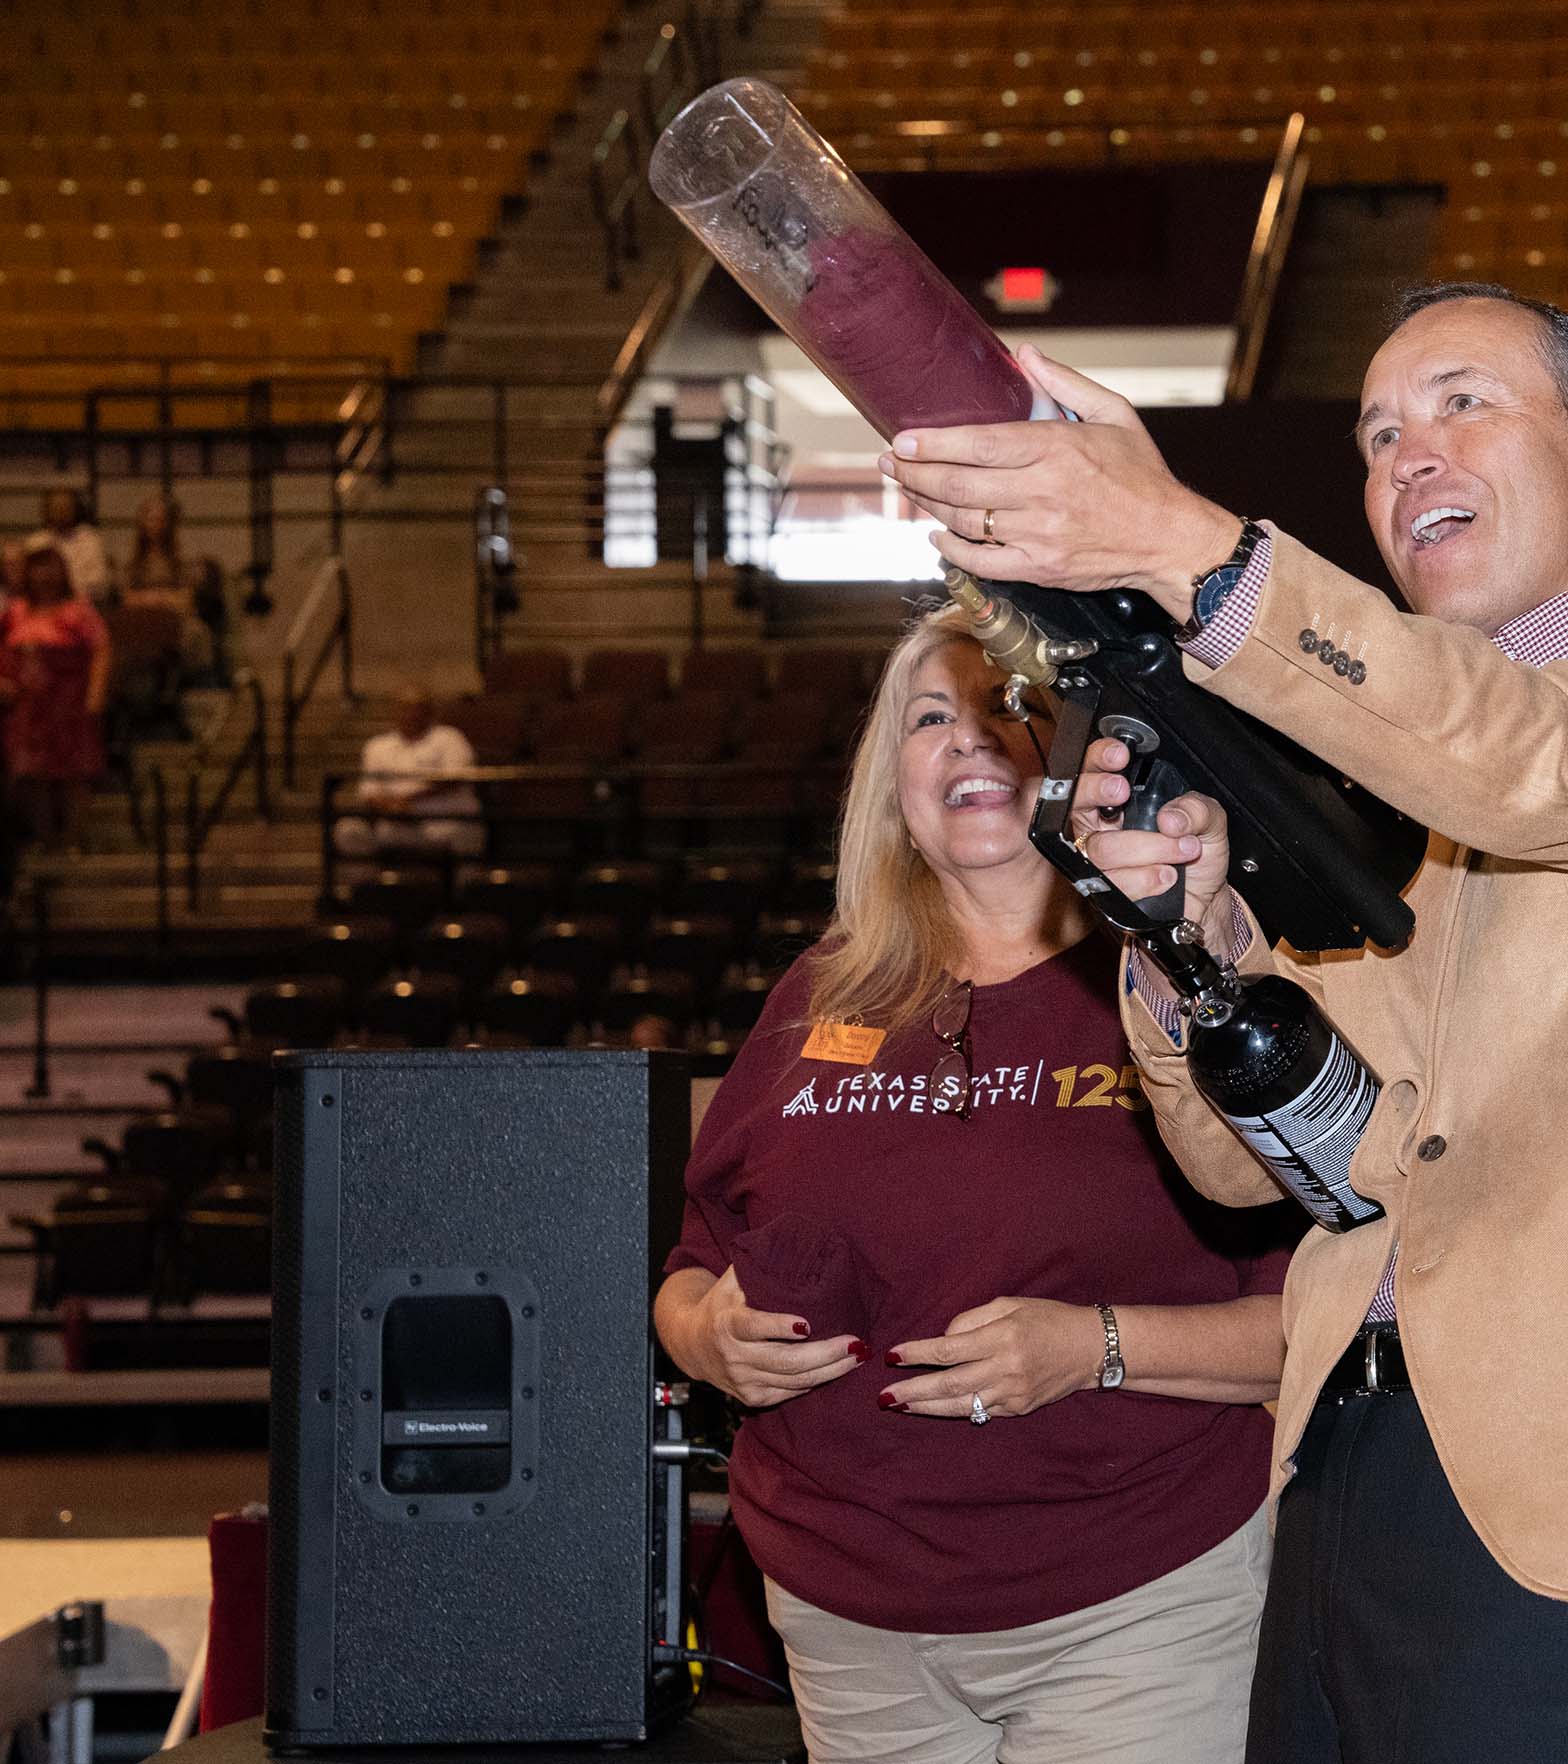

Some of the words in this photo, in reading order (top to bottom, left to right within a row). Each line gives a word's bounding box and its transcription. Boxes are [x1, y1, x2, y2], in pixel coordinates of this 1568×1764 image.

[836, 1071, 927, 1095] TEXAS
[1051, 1063, 1148, 1112] 125
[824, 1083, 1027, 1114] UNIVERITY.
[418, 1422, 488, 1433] Electro-Voice
